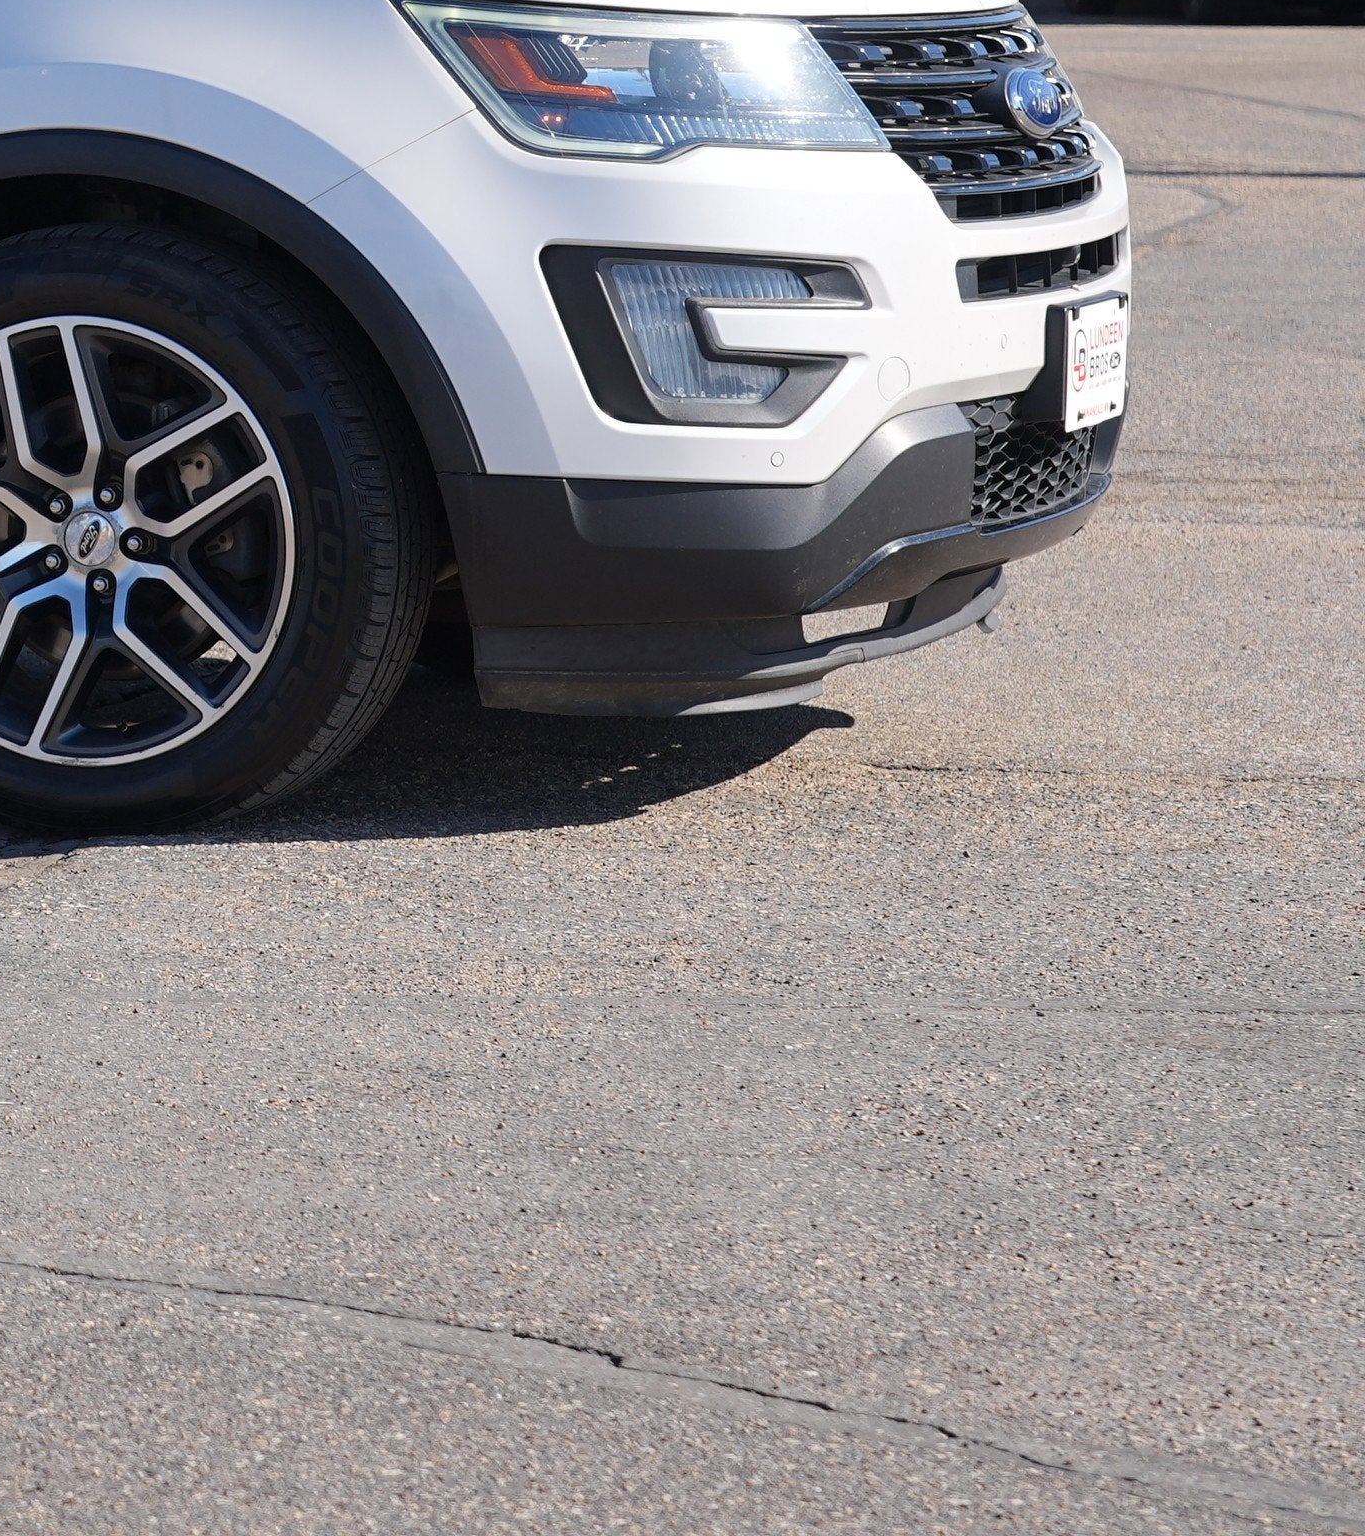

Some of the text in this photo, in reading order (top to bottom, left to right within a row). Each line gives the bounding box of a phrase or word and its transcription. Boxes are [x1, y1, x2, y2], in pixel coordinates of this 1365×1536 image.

[1028, 79, 1058, 116] Ford
[124, 273, 220, 328] SRX
[1089, 321, 1124, 350] LUNDEEN
[1089, 351, 1109, 379] BROS
[80, 524, 99, 554] Ford
[249, 486, 344, 744] COOPER
